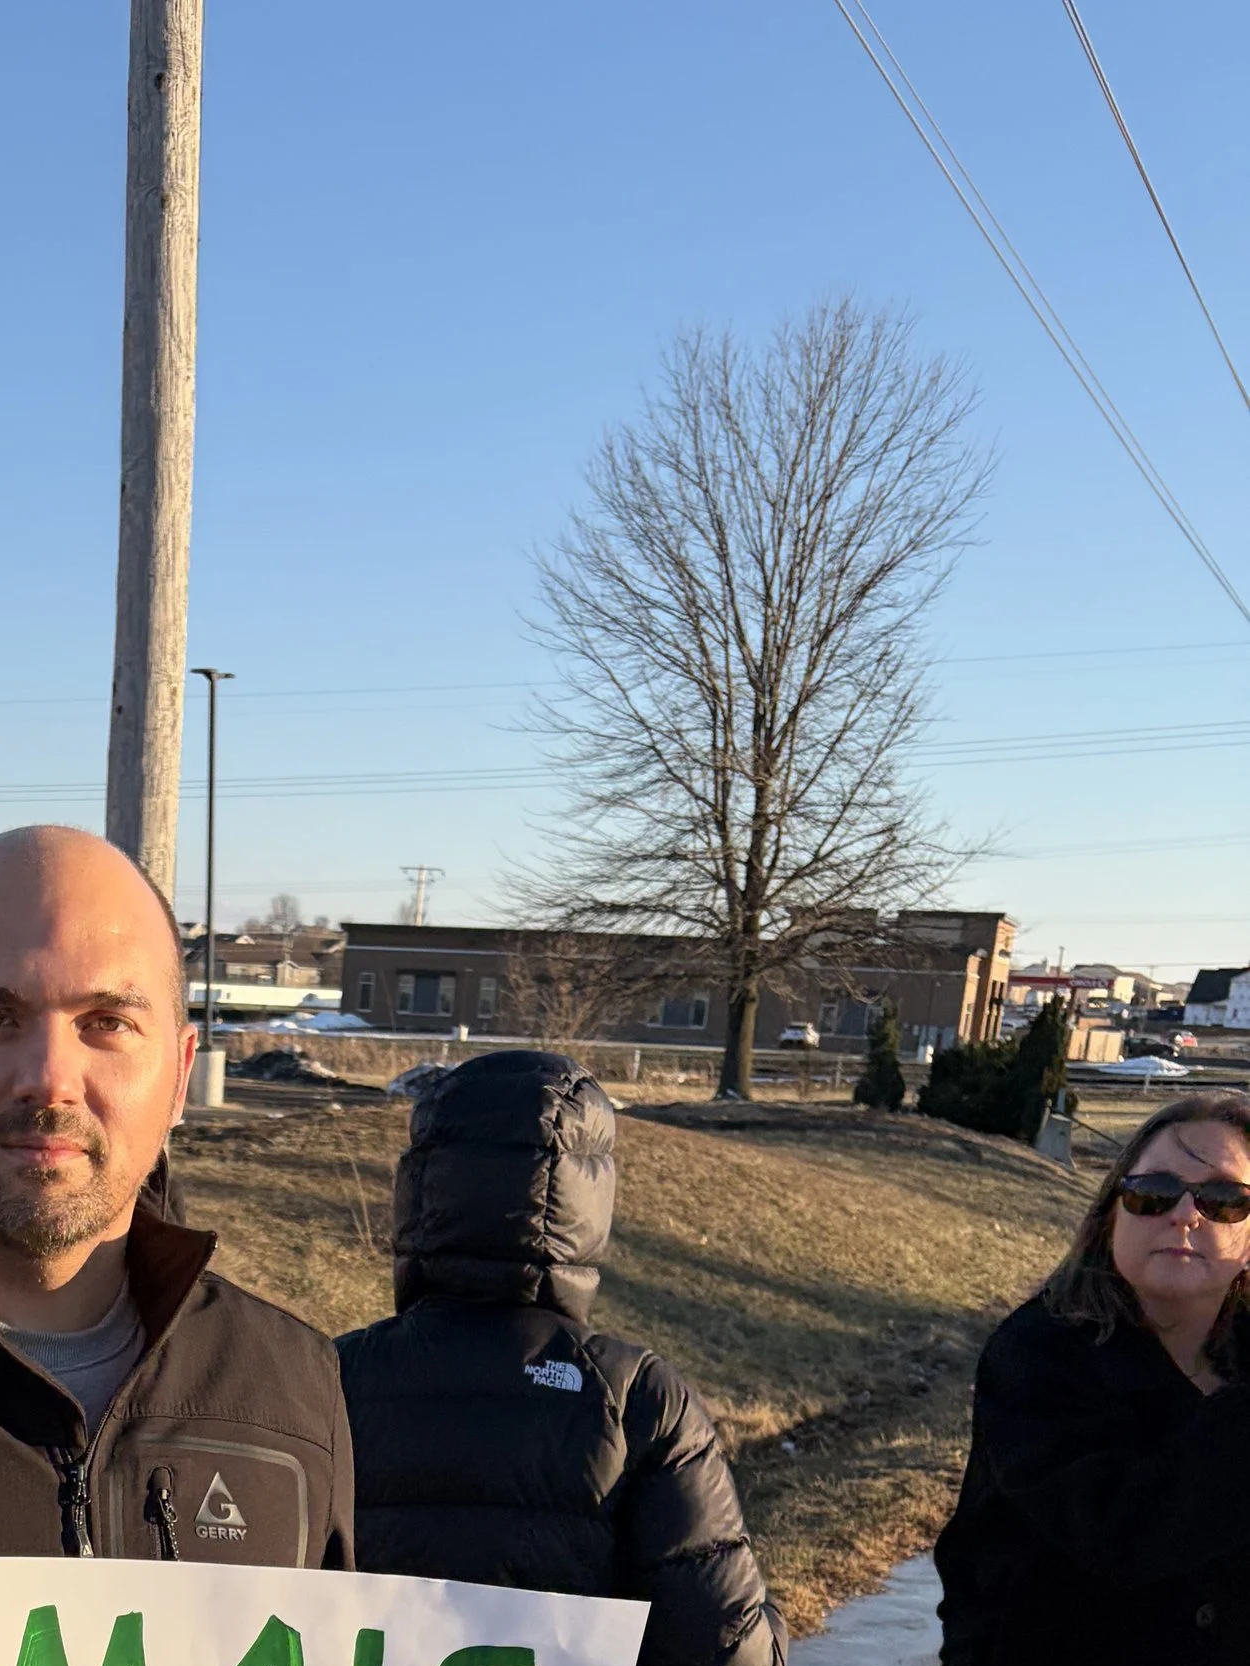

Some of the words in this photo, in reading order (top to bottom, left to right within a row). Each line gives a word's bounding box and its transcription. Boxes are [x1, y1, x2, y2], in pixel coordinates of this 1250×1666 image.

[524, 1364, 564, 1380] NORTH
[545, 1360, 566, 1371] THE
[533, 1375, 563, 1388] FACE
[195, 1525, 247, 1540] GERRY
